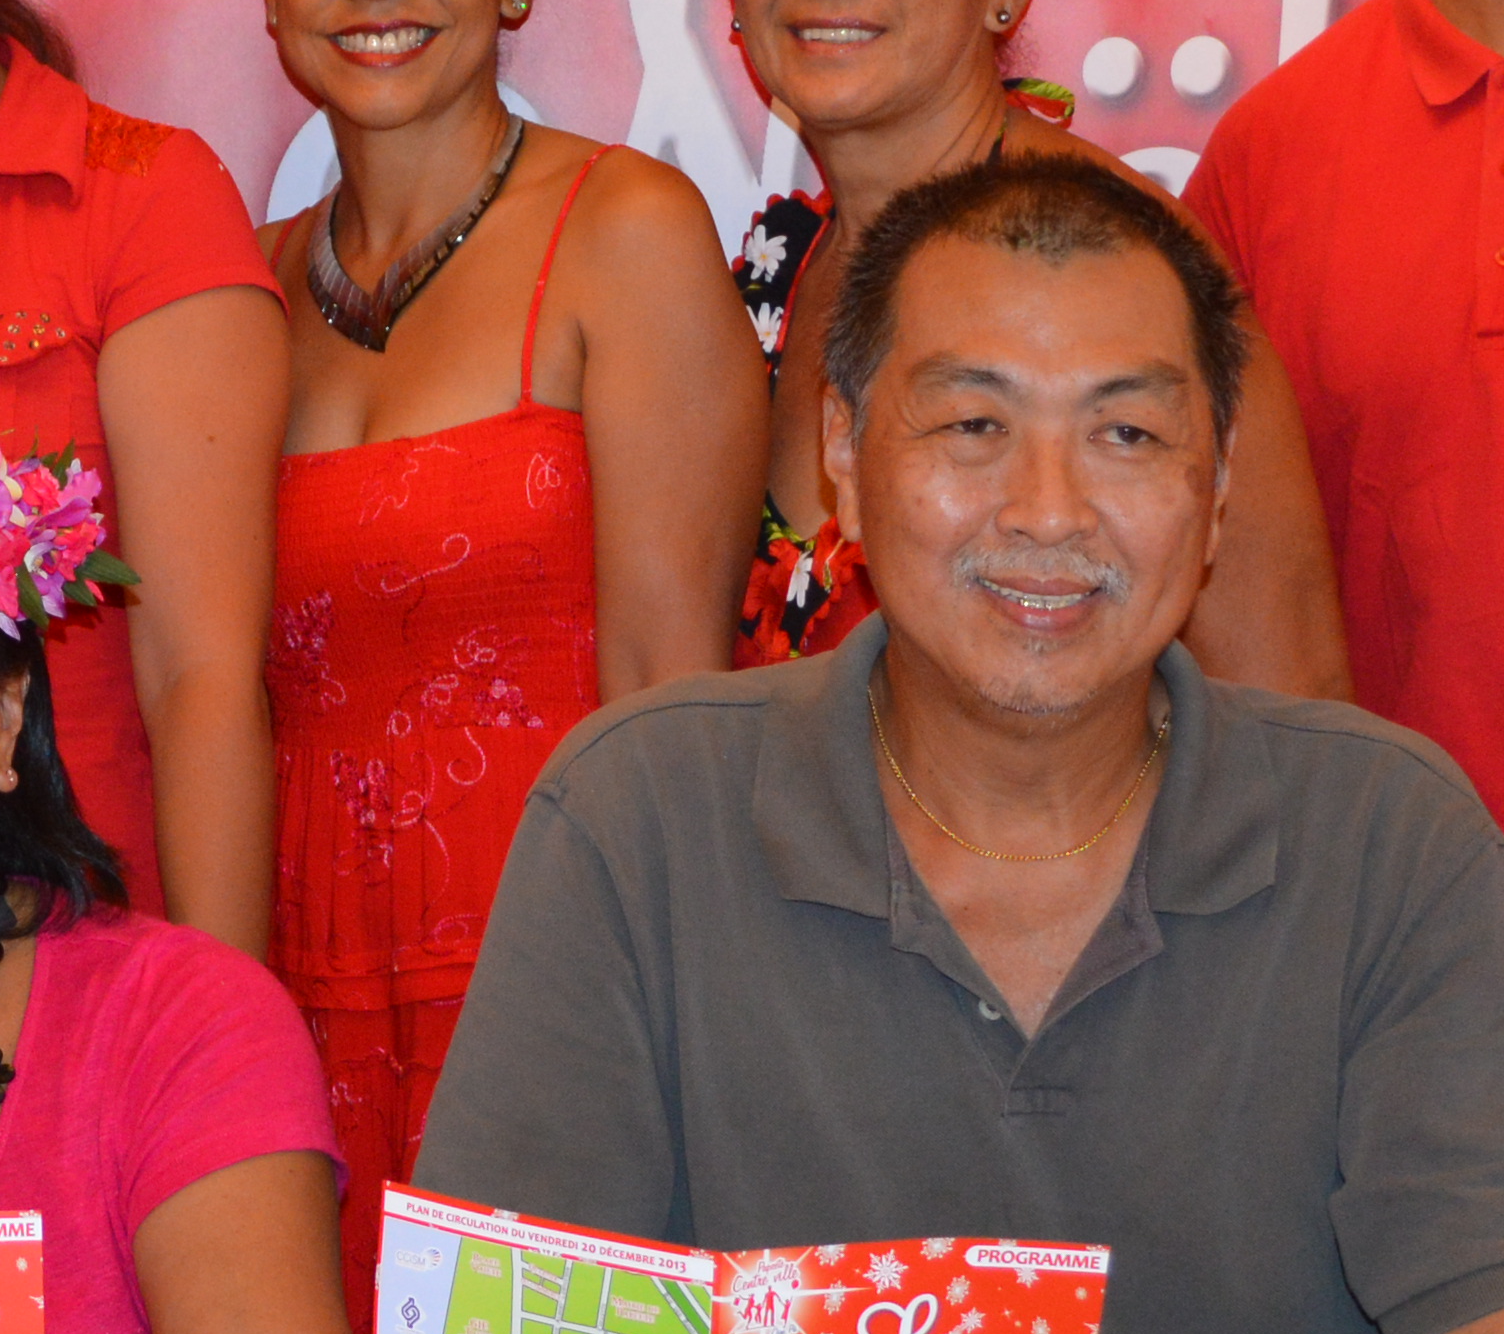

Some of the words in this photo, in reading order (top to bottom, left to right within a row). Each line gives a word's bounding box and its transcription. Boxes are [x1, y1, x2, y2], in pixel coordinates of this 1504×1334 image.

[406, 1202, 430, 1215] PLAN
[432, 1209, 444, 1219] DE
[446, 1212, 509, 1235] CIRCULATION
[511, 1227, 525, 1238] DU
[528, 1231, 579, 1251] VENDREDI
[581, 1242, 596, 1254] 20
[599, 1244, 656, 1266] DÉCEMBRE
[658, 1257, 686, 1273] 2013
[976, 1246, 1101, 1271] PROGRAMME
